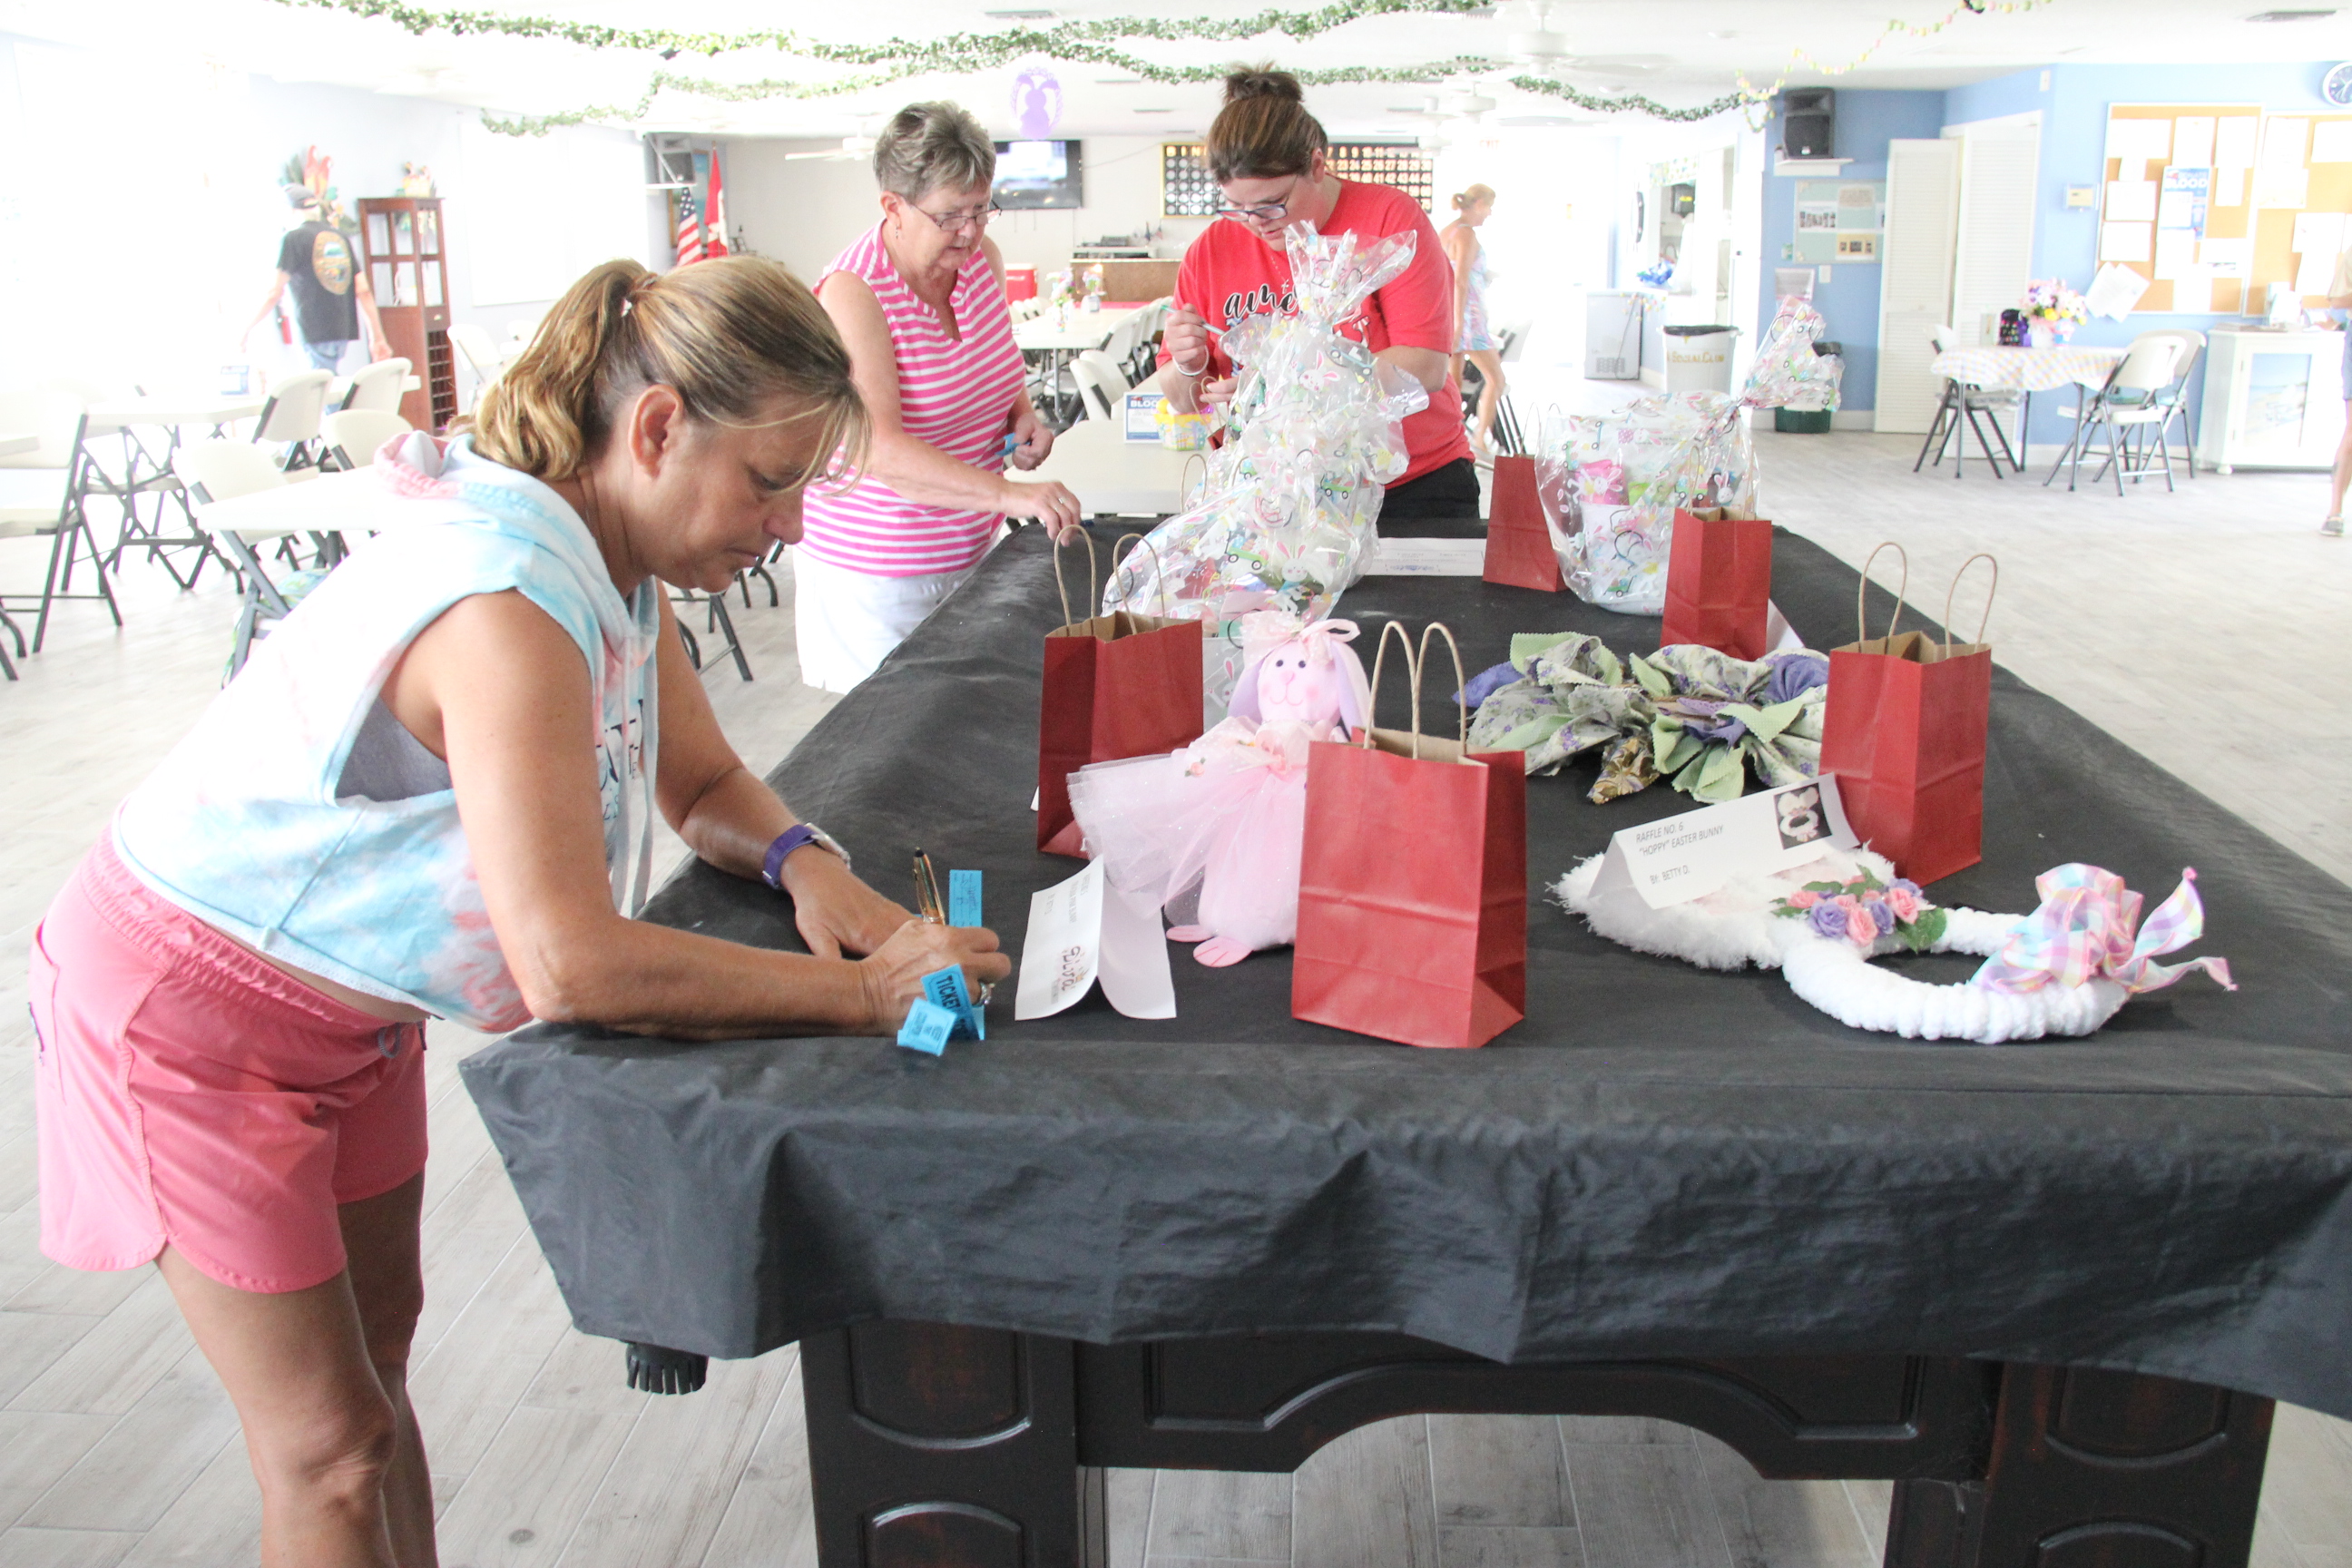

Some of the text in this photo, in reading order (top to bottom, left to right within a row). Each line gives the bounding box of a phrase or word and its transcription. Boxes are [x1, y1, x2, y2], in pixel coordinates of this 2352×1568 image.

[1166, 145, 1207, 158] BIN
[2164, 177, 2208, 189] BLOOD
[1224, 283, 1298, 318] ame
[1130, 399, 1157, 408] BLOO
[1636, 821, 1684, 843] RAFFLE NO. 6
[1671, 832, 1698, 848] EASTER
[1698, 824, 1724, 840] BUNNY
[1661, 867, 1681, 881] BETTY
[936, 974, 961, 1009] TICKET
